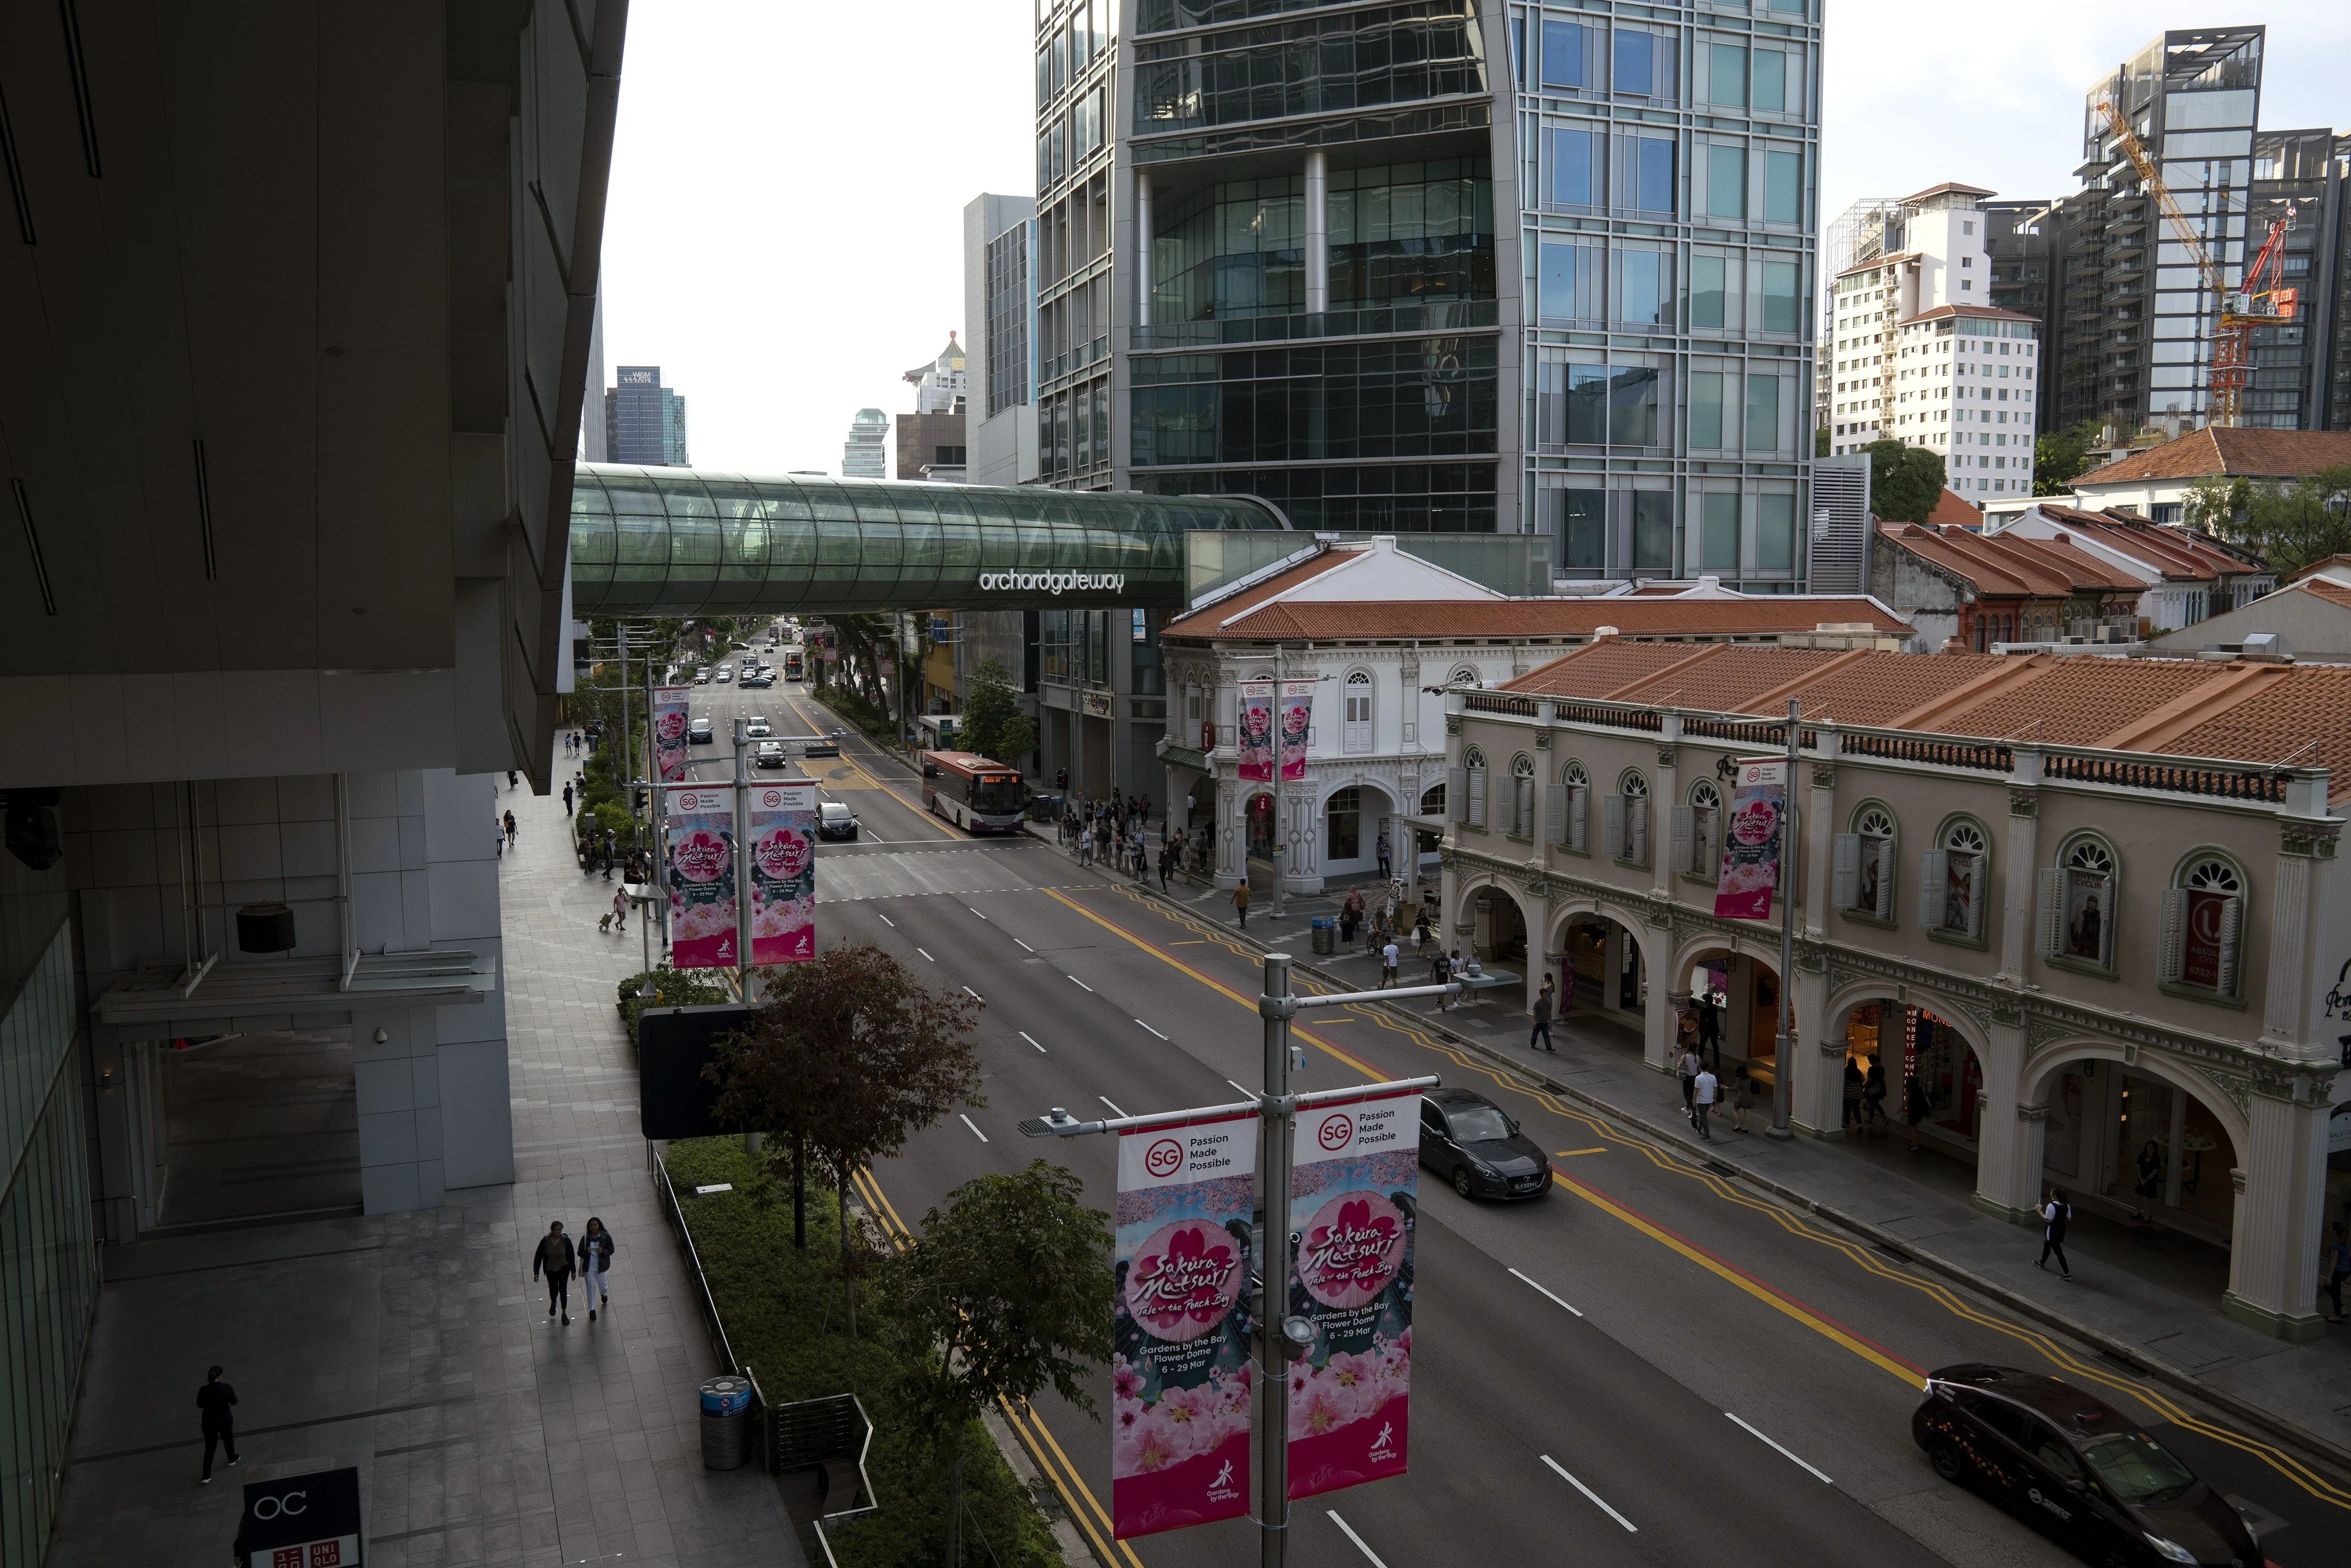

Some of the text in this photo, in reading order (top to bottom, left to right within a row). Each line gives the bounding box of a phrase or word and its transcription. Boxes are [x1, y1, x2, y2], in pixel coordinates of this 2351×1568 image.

[979, 568, 1124, 595] orchardgateway
[683, 843, 718, 854] Sakura
[764, 840, 799, 852] Sakura
[1865, 843, 1880, 851] CYCL
[678, 850, 726, 865] Matsuri
[759, 847, 808, 860] Matsuri
[1953, 859, 1971, 867] CYCLI
[2075, 872, 2102, 882] RHYTH
[2075, 879, 2102, 890] CYCLIN
[2191, 946, 2219, 957] ABSOL
[2199, 956, 2219, 965] CYCL
[2189, 966, 2218, 979] 6732-1
[1359, 1110, 1395, 1122] Passion
[1323, 1124, 1348, 1141] SG
[1359, 1122, 1384, 1133] Made
[2329, 1130, 2351, 1138] WALK-T
[1190, 1135, 1229, 1147] Passion
[1358, 1131, 1396, 1145] Possible
[1150, 1148, 1179, 1167] SG
[1190, 1148, 1217, 1159] Made
[1189, 1157, 1231, 1171] Possible
[1313, 1225, 1384, 1249] Sakura
[1303, 1232, 1401, 1272] Matsuri
[1142, 1254, 1220, 1279] Sakura
[1310, 1275, 1326, 1285] Tale
[1336, 1272, 1349, 1280] the
[1350, 1265, 1374, 1279] Peach
[1375, 1261, 1393, 1275] Boy
[1131, 1261, 1237, 1302] Matsuri
[1138, 1305, 1157, 1316] Tale
[1167, 1304, 1182, 1312] the
[1184, 1296, 1210, 1311] Peach
[1211, 1293, 1230, 1307] Boy
[1310, 1302, 1389, 1322] Gardens by the Bay
[1322, 1315, 1375, 1329] Flower Dome
[1343, 1329, 1354, 1338] 29
[1356, 1327, 1371, 1336] Mar
[1140, 1335, 1227, 1355] Gardens by the Bay
[1154, 1348, 1211, 1363] Flower Dome
[1161, 1365, 1168, 1373] 6
[1177, 1363, 1188, 1372] 29
[1190, 1359, 1205, 1369] Mar
[1369, 1449, 1389, 1458] Gardens
[254, 1490, 307, 1520] OC
[277, 1550, 300, 1563] ユニ
[313, 1544, 334, 1556] UNI
[313, 1554, 337, 1567] QLO
